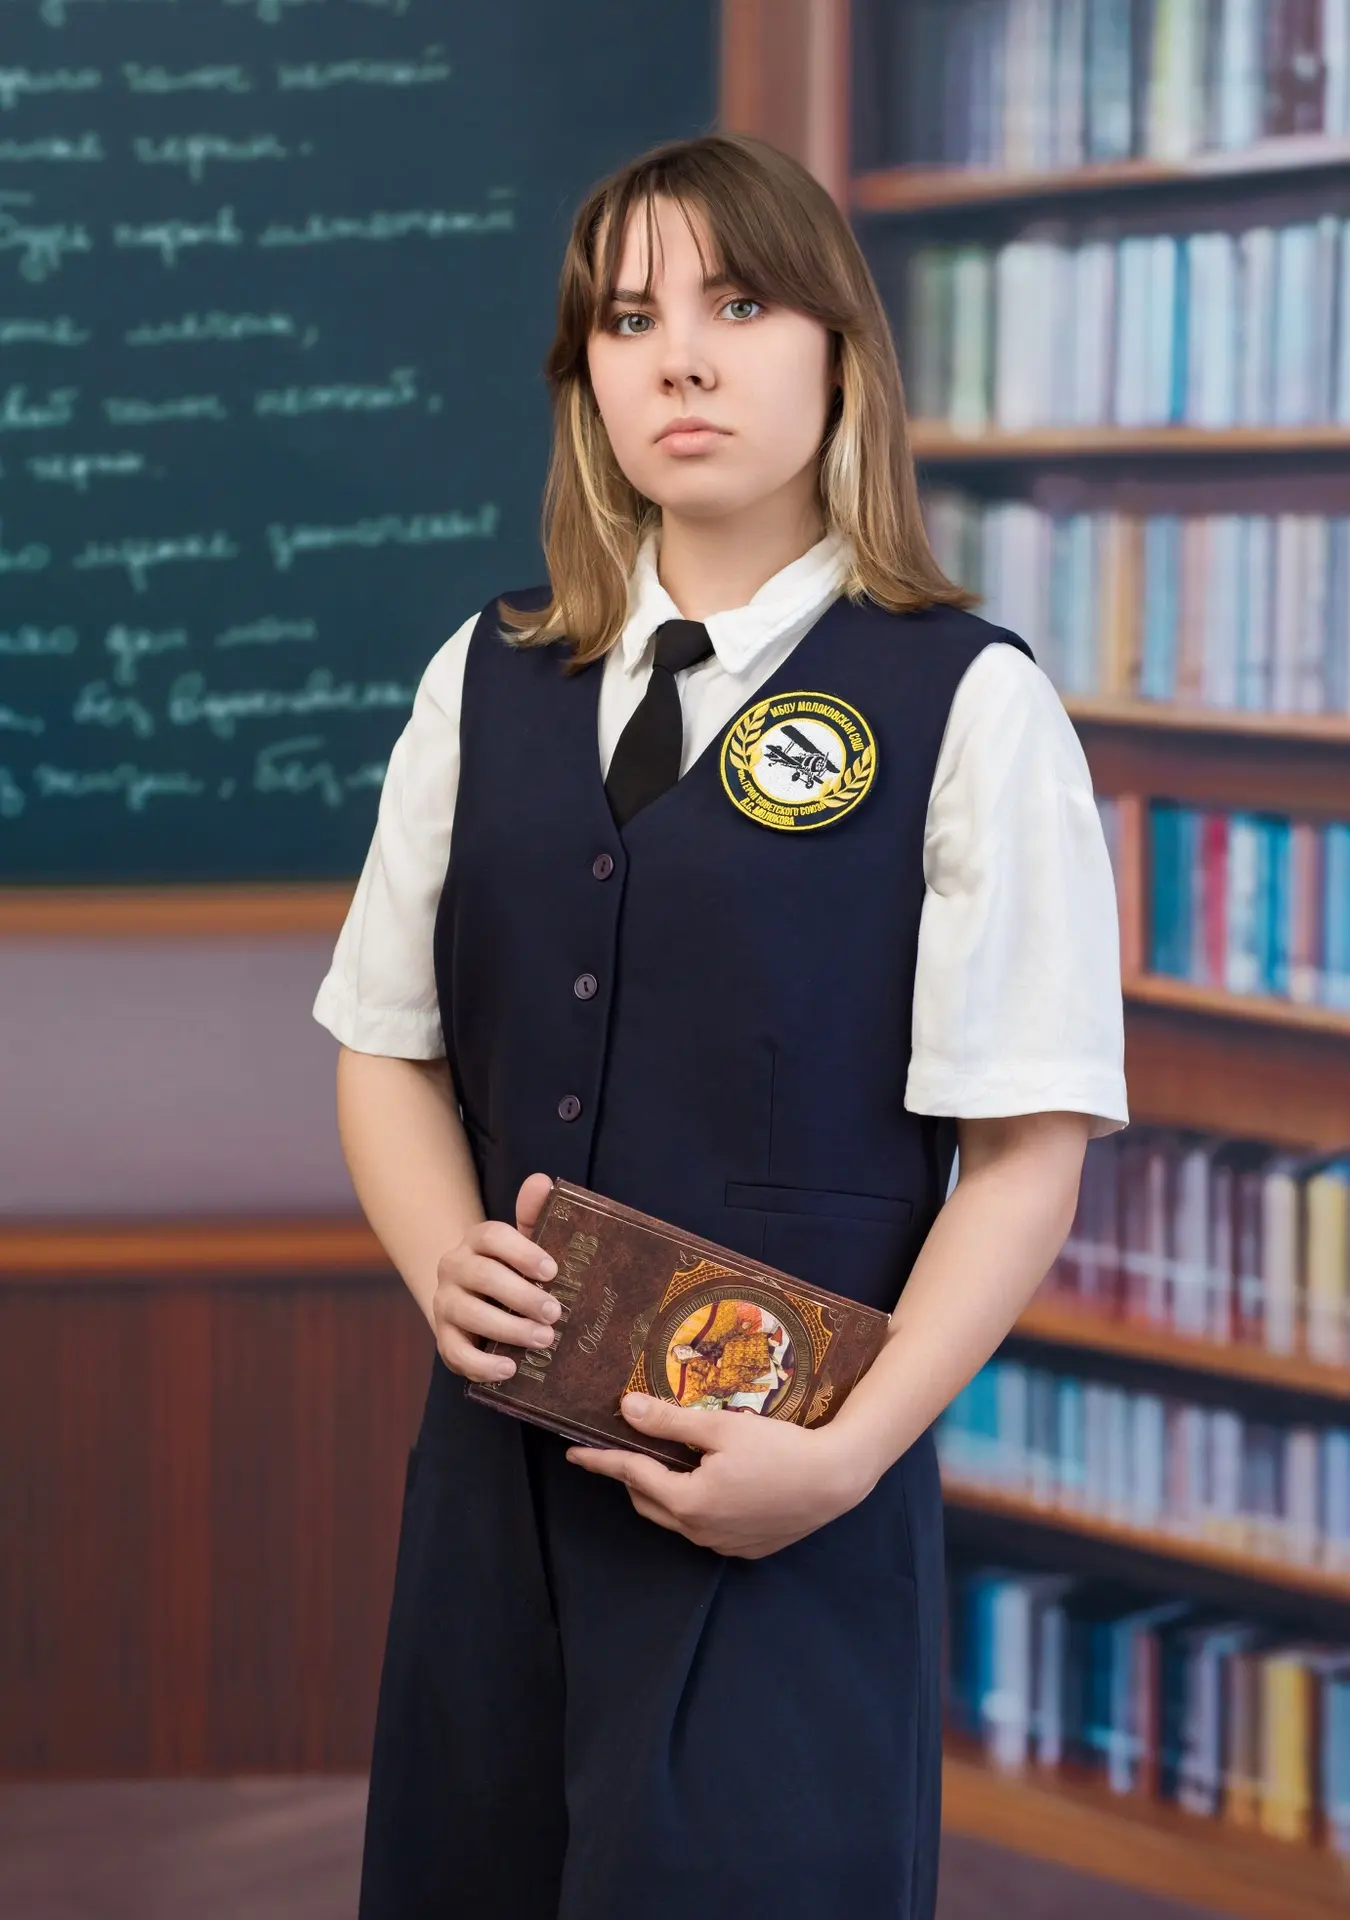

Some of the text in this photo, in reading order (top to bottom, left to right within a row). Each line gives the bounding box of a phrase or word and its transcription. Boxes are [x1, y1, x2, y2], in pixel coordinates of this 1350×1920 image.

[769, 700, 865, 752] МБОУ МОЛОКОВСКАЯ СОШ
[751, 806, 795, 826] МОЛОКОВА
[755, 795, 799, 816] СОВЕТСКОГО
[799, 801, 827, 816] СОЮЗА
[517, 1231, 600, 1383] ГОАРОВ
[577, 1285, 619, 1355] Обломов
